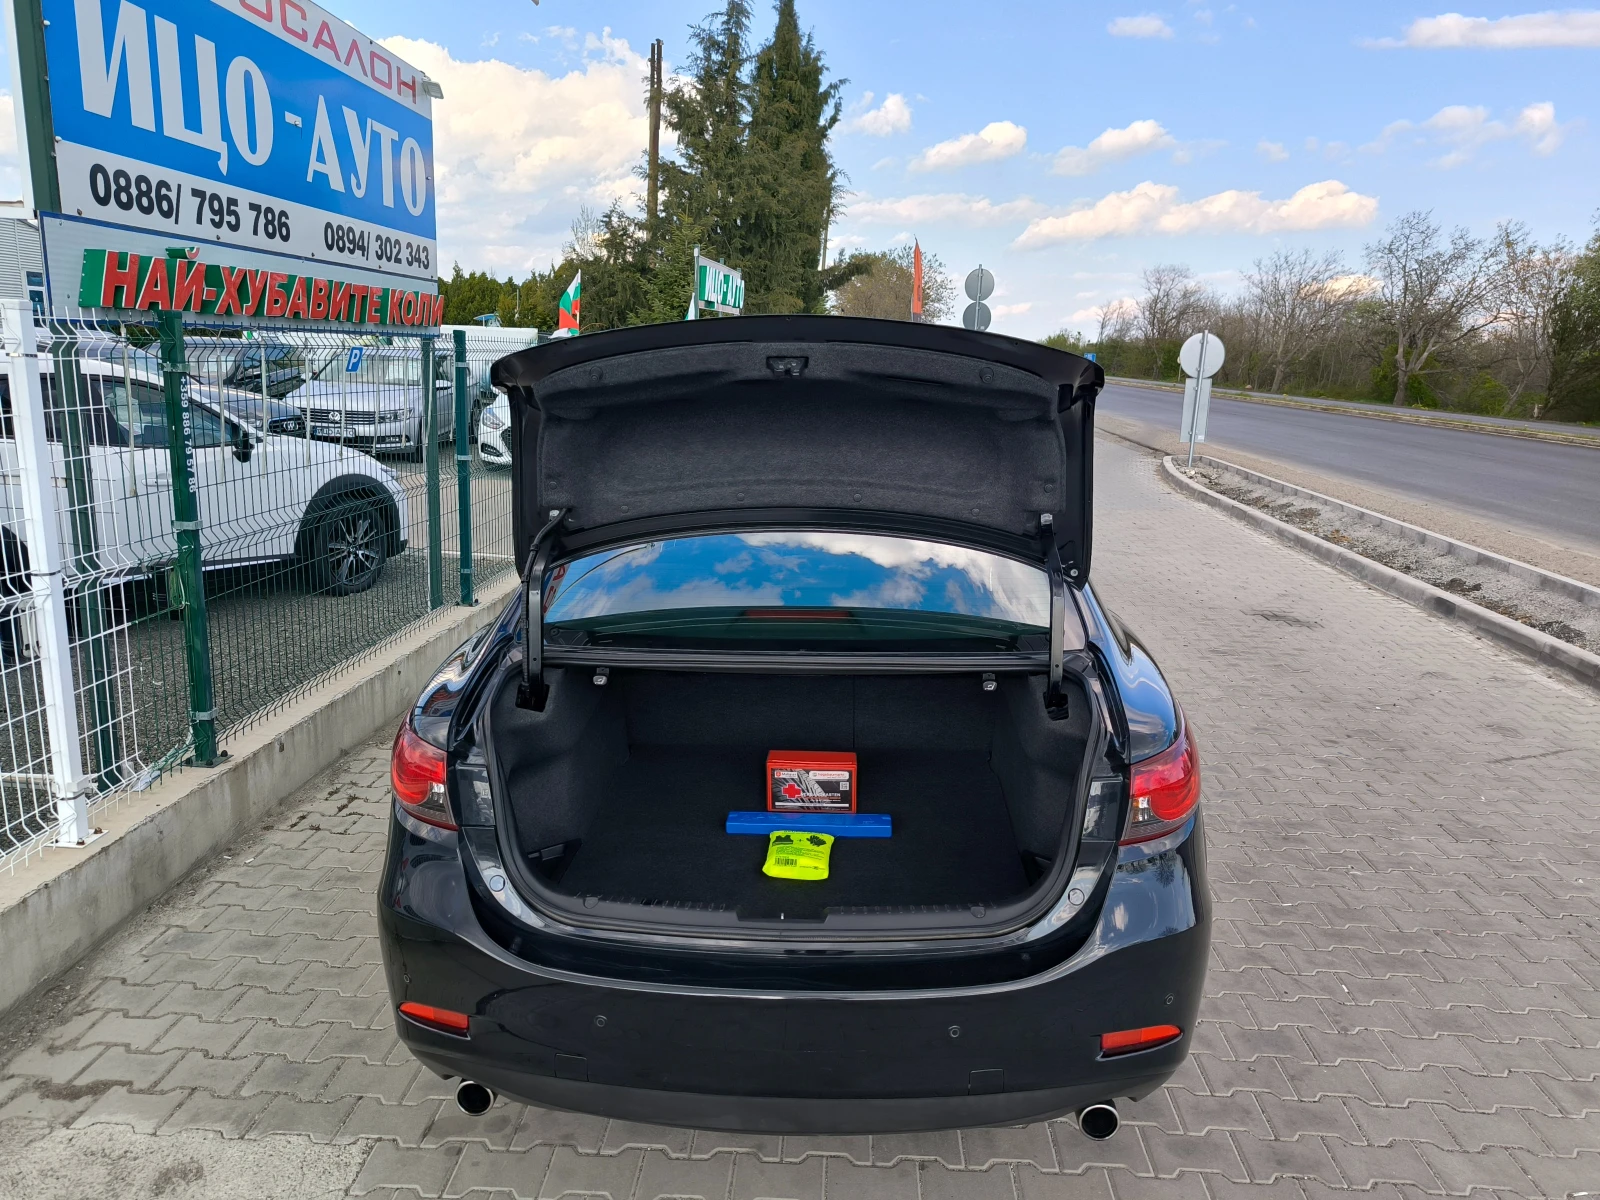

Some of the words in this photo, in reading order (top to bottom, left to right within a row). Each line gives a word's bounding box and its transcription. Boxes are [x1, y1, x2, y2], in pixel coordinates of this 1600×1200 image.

[89, 163, 182, 225] 0886/
[191, 188, 241, 233] 795
[248, 203, 291, 242] 786
[324, 221, 370, 261] 0894/
[374, 237, 403, 265] 302
[406, 242, 430, 270] 343
[101, 246, 383, 325] НАЙ-ХУБАВИТЕ
[387, 287, 444, 327] КОЛИ
[180, 375, 188, 408] +359
[182, 412, 191, 436] 886
[184, 438, 193, 455] 79
[186, 459, 195, 473] 57
[188, 477, 197, 493] 86
